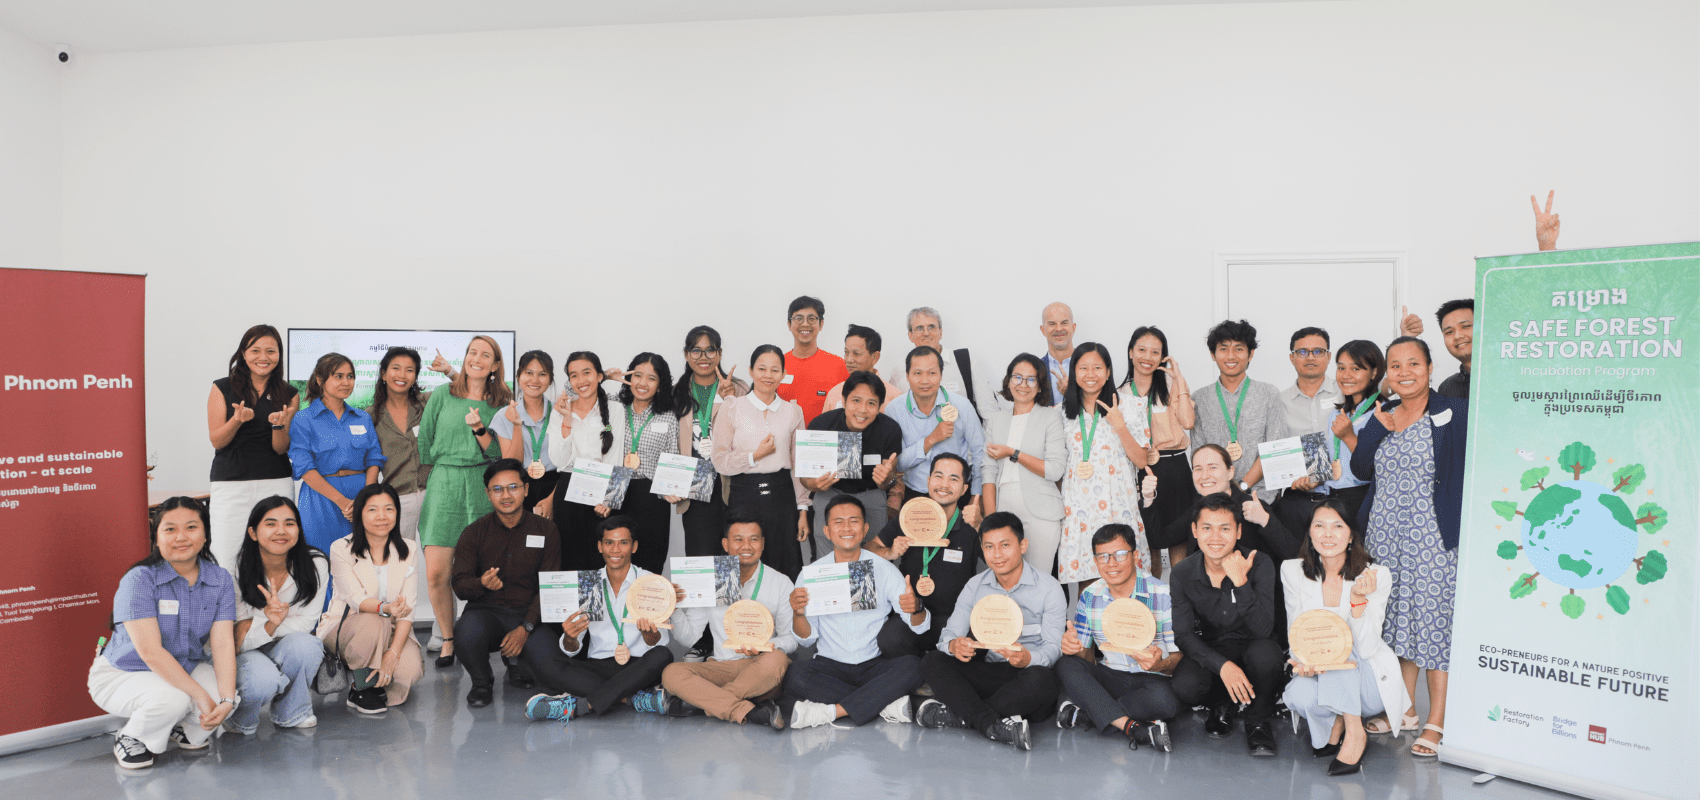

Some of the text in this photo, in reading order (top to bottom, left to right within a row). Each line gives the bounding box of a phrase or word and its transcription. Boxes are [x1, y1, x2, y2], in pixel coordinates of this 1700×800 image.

[1552, 288, 1628, 313] គម្រោង
[1508, 316, 1676, 338] SAFE FOREST
[1500, 339, 1683, 359] RESTORATION
[1521, 366, 1656, 379] Incubation Program
[4, 374, 133, 391] Phnom Penh
[17, 454, 44, 464] and
[47, 450, 124, 462] sustainable
[41, 467, 56, 477] at
[58, 465, 93, 476] scale
[19, 585, 36, 593] Penh
[58, 600, 86, 609] Chamkar
[0, 615, 34, 624] Cambodia
[1479, 645, 1669, 684] ECO-PRENEURS FOR A NATURE POSITIVE
[1478, 655, 1669, 702] SUSTAINABLE FUTURE
[1503, 708, 1545, 722] Restoration
[1503, 715, 1530, 727] Factory
[1552, 715, 1577, 727] Bridge
[1552, 721, 1563, 729] for
[1551, 728, 1577, 740] Billions
[1589, 733, 1605, 742] HUB
[1608, 737, 1651, 752] Phnom Penh
